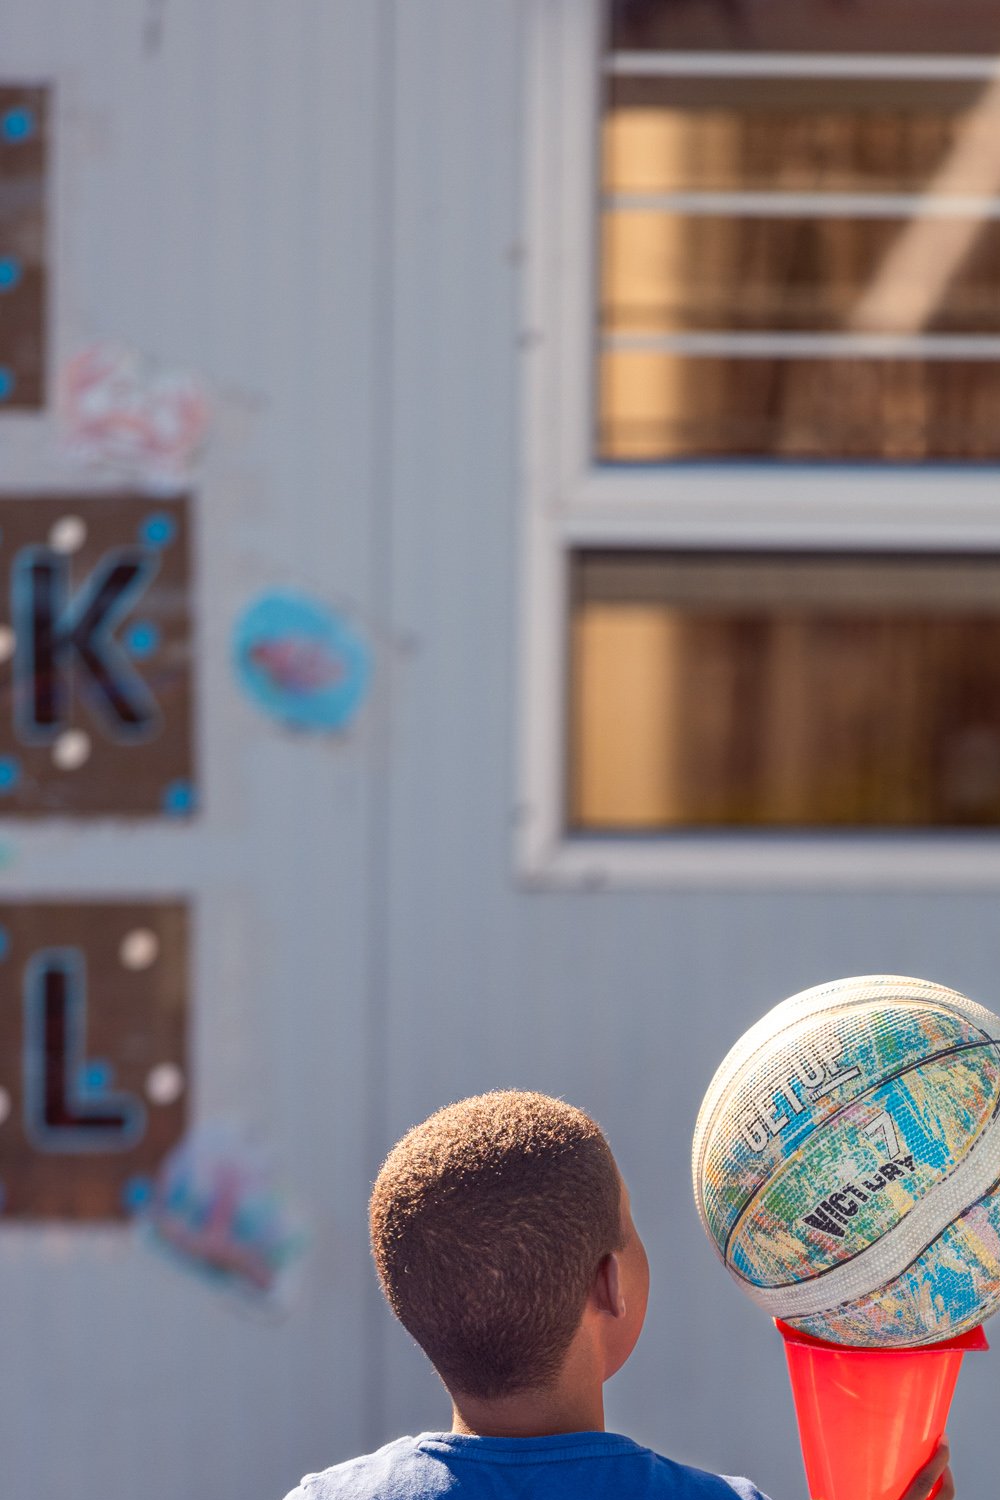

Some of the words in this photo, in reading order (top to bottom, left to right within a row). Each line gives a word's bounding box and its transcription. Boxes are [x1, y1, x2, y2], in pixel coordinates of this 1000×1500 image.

[13, 545, 160, 744] K
[24, 946, 147, 1153] L
[801, 1154, 916, 1238] VICTORY
[862, 1110, 900, 1160] 7
